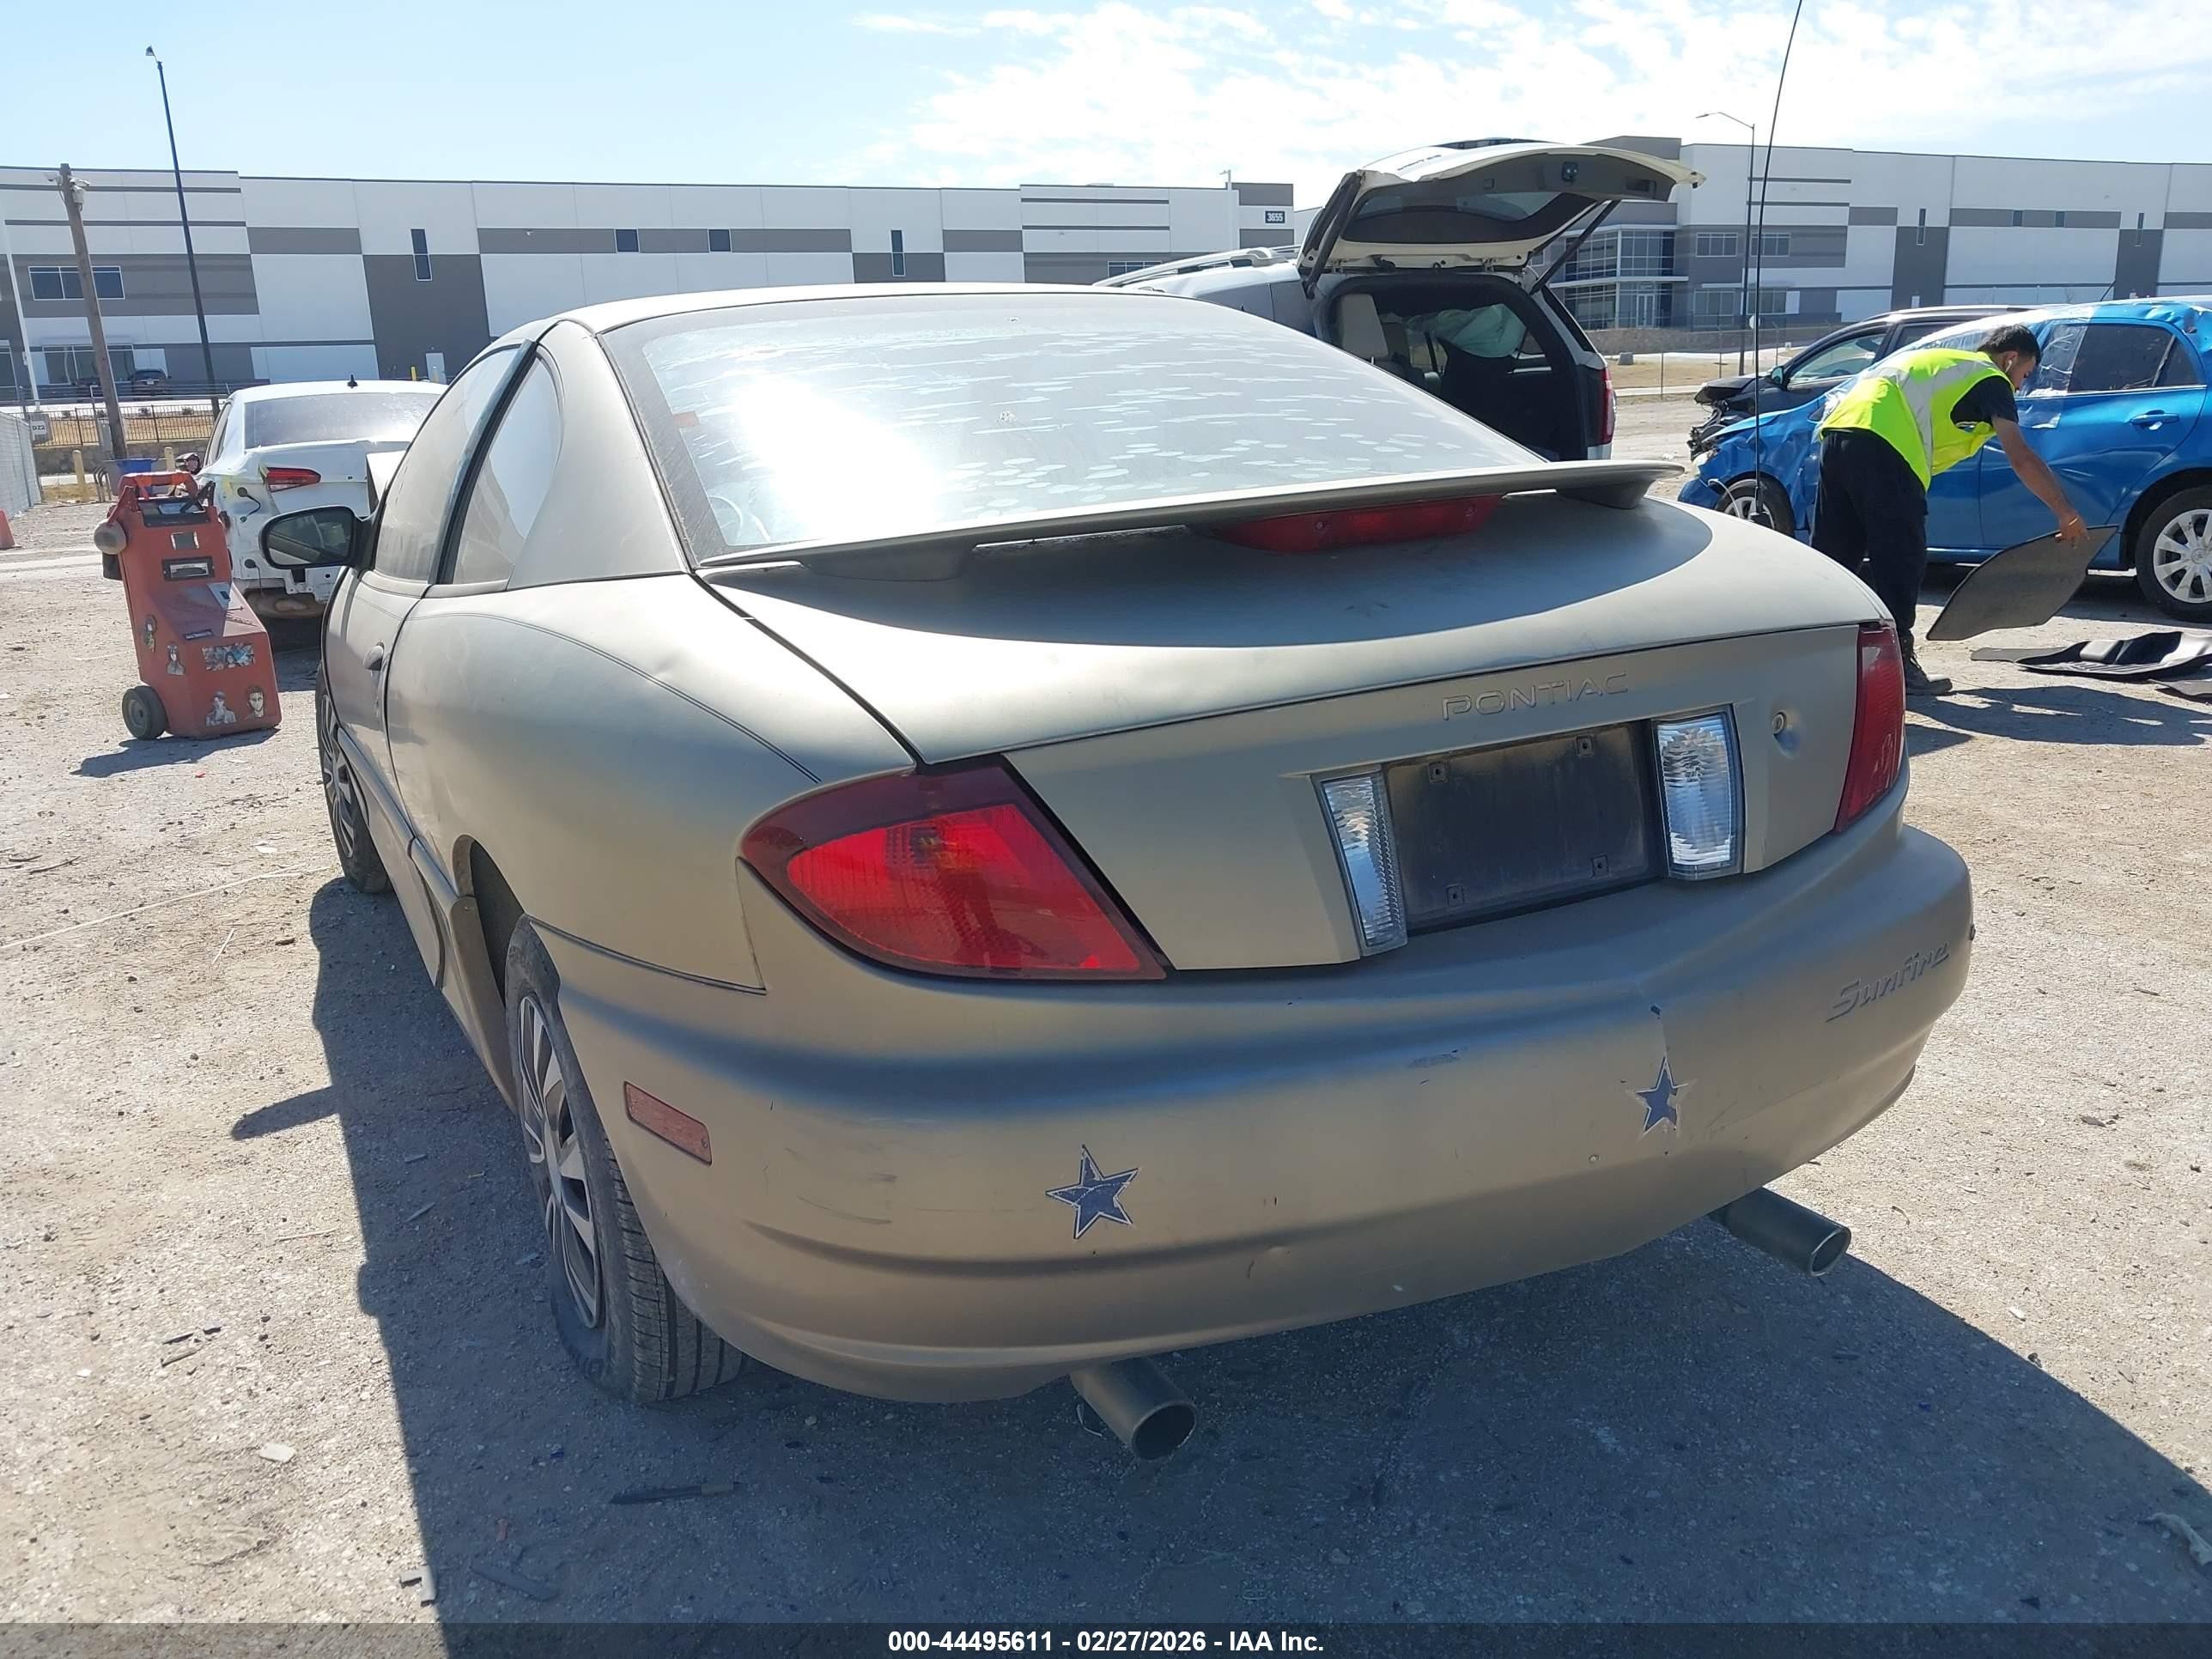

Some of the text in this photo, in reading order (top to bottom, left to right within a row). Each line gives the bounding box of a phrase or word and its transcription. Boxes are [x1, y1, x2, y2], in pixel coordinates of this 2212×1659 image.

[1267, 212, 1284, 222] 3655
[1442, 672, 1628, 720] PONTIAC
[1826, 942, 1950, 1023] Sunfire
